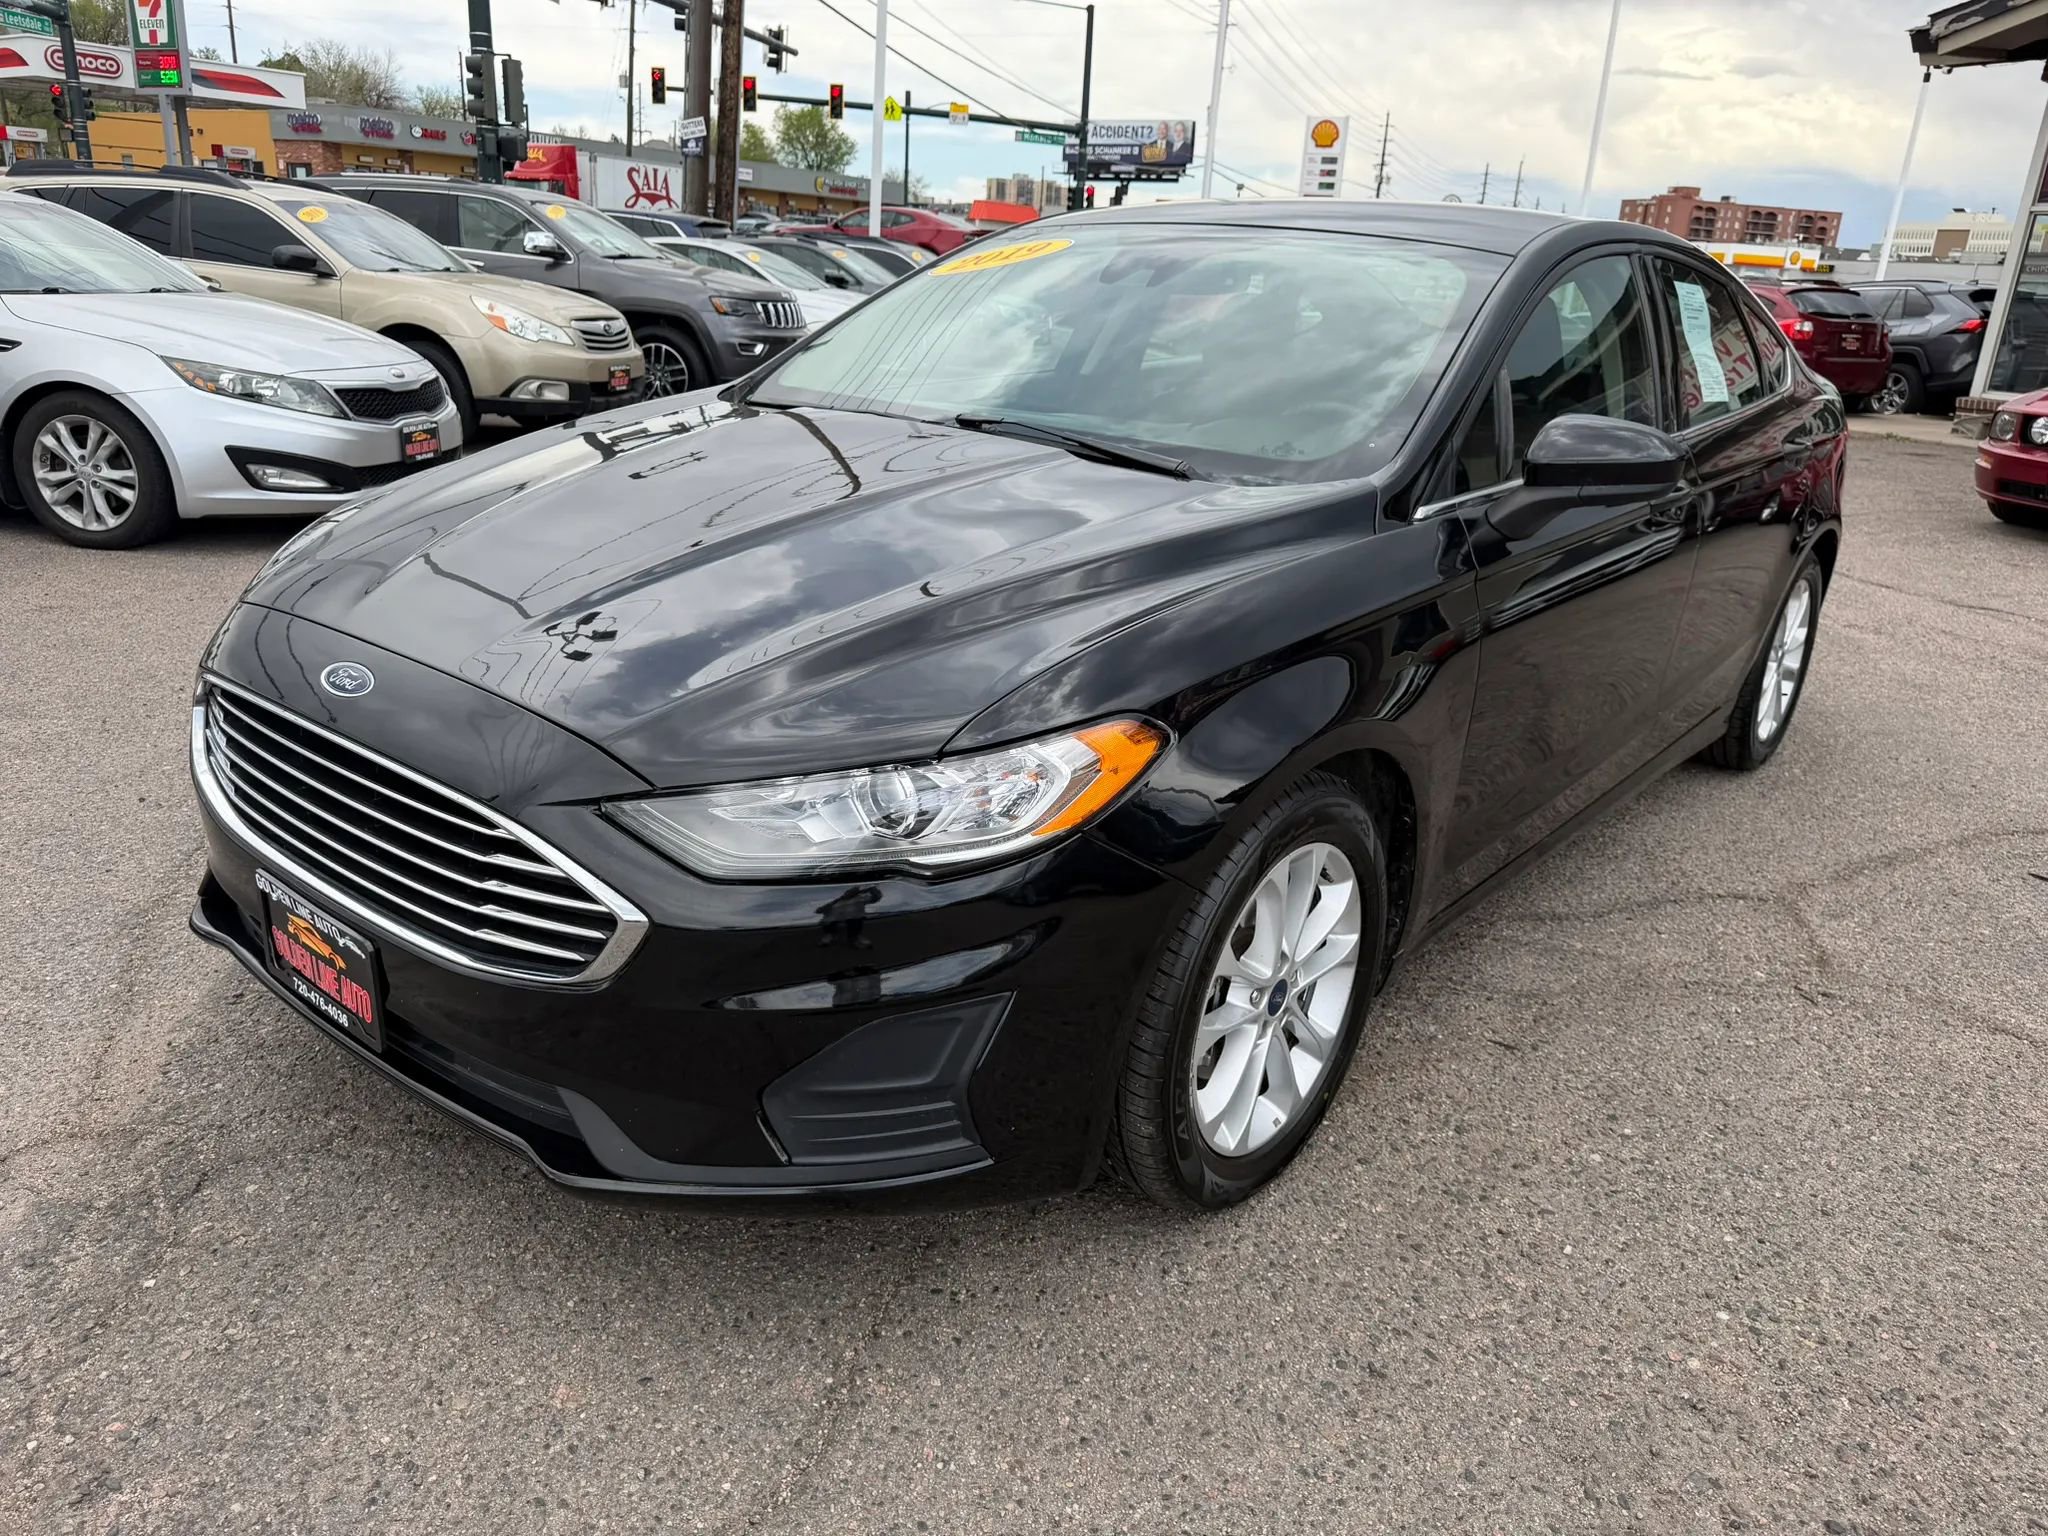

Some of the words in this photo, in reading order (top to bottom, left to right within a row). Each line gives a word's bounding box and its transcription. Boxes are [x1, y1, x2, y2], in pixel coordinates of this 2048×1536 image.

[4, 12, 42, 31] Leetsdale
[139, 19, 165, 29] ELEVEN
[53, 51, 118, 72] cnoco
[1091, 125, 1153, 139] ACCIDENT?
[624, 166, 679, 209] SAIA
[329, 667, 362, 690] Ford
[255, 873, 293, 909] GOLDEN
[291, 898, 314, 924] LINE
[314, 915, 340, 940] AUTO
[271, 925, 313, 982] GOLDEN
[312, 954, 340, 1001] LINE
[341, 974, 373, 1024] AUTO
[292, 977, 349, 1027] 720-476-4036
